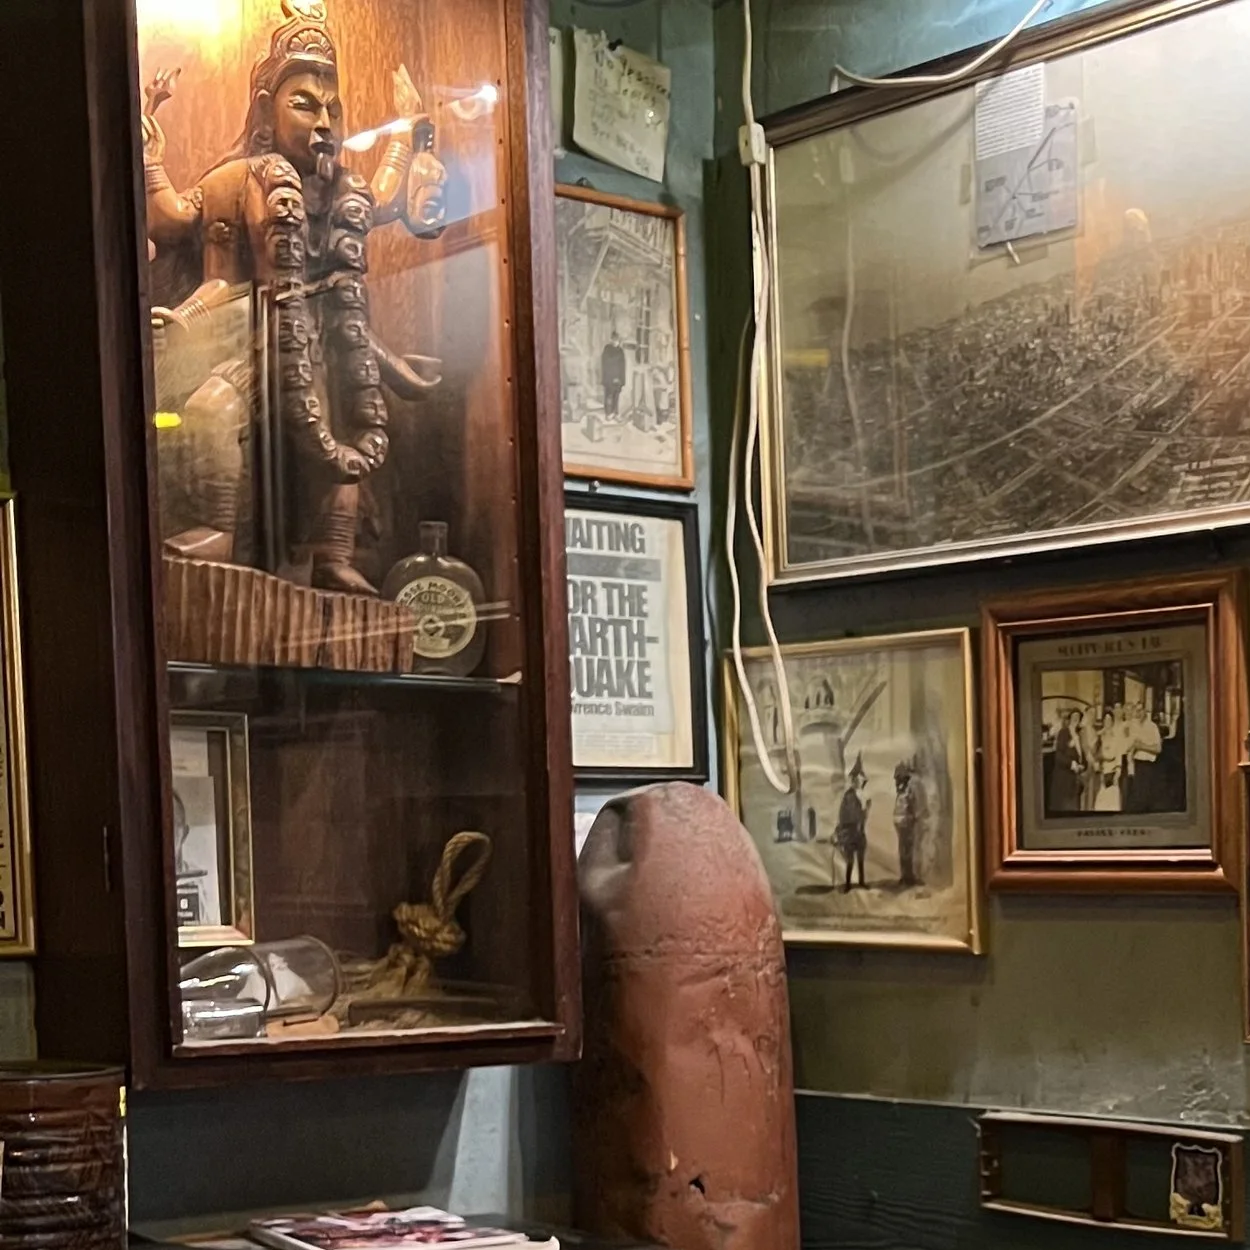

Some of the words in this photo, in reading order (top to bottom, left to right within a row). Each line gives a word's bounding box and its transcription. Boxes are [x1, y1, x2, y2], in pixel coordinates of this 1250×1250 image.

[565, 518, 646, 554] AITING
[421, 594, 445, 605] OLD
[601, 582, 648, 618] THE
[571, 656, 653, 699] UAKE
